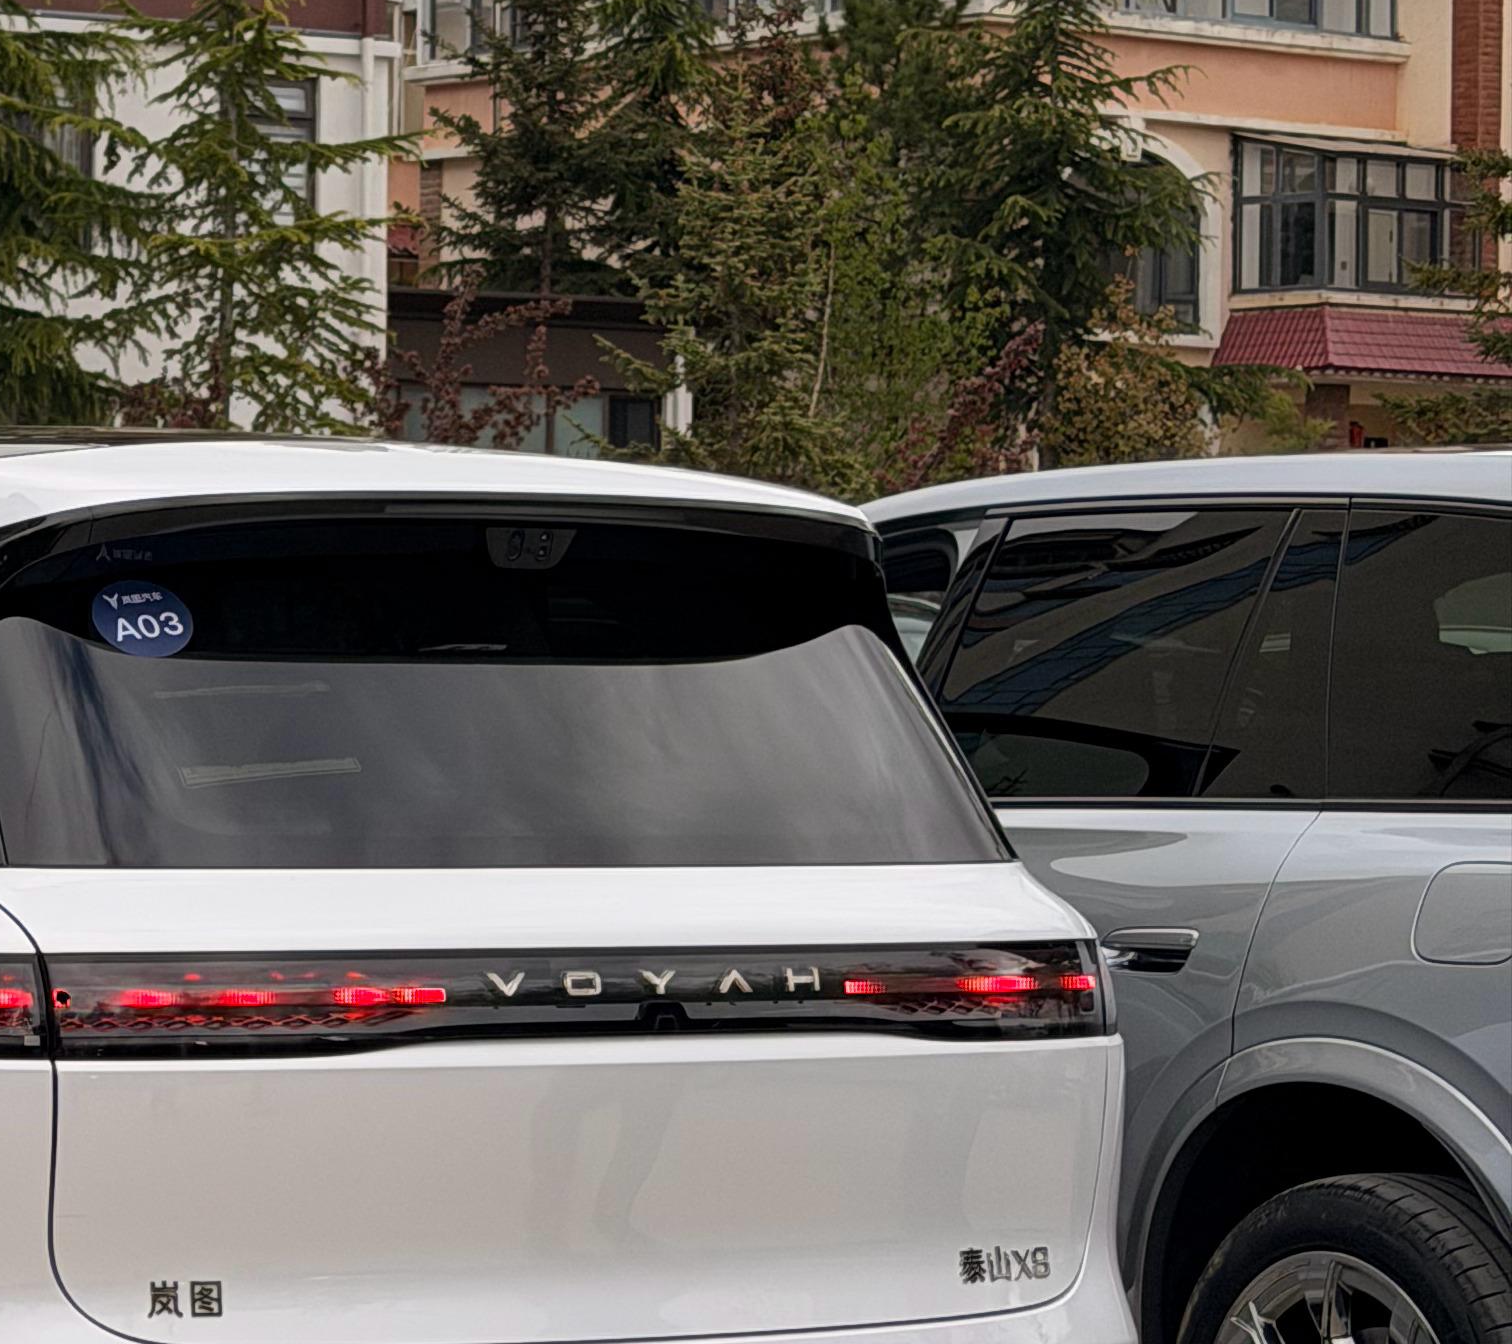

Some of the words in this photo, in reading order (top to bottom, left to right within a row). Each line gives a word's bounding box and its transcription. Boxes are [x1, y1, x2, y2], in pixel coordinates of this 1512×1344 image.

[116, 611, 185, 643] A03
[486, 965, 821, 998] VOYAH
[958, 1245, 1051, 1285] 泰山X8
[147, 1279, 224, 1319] 岚图
